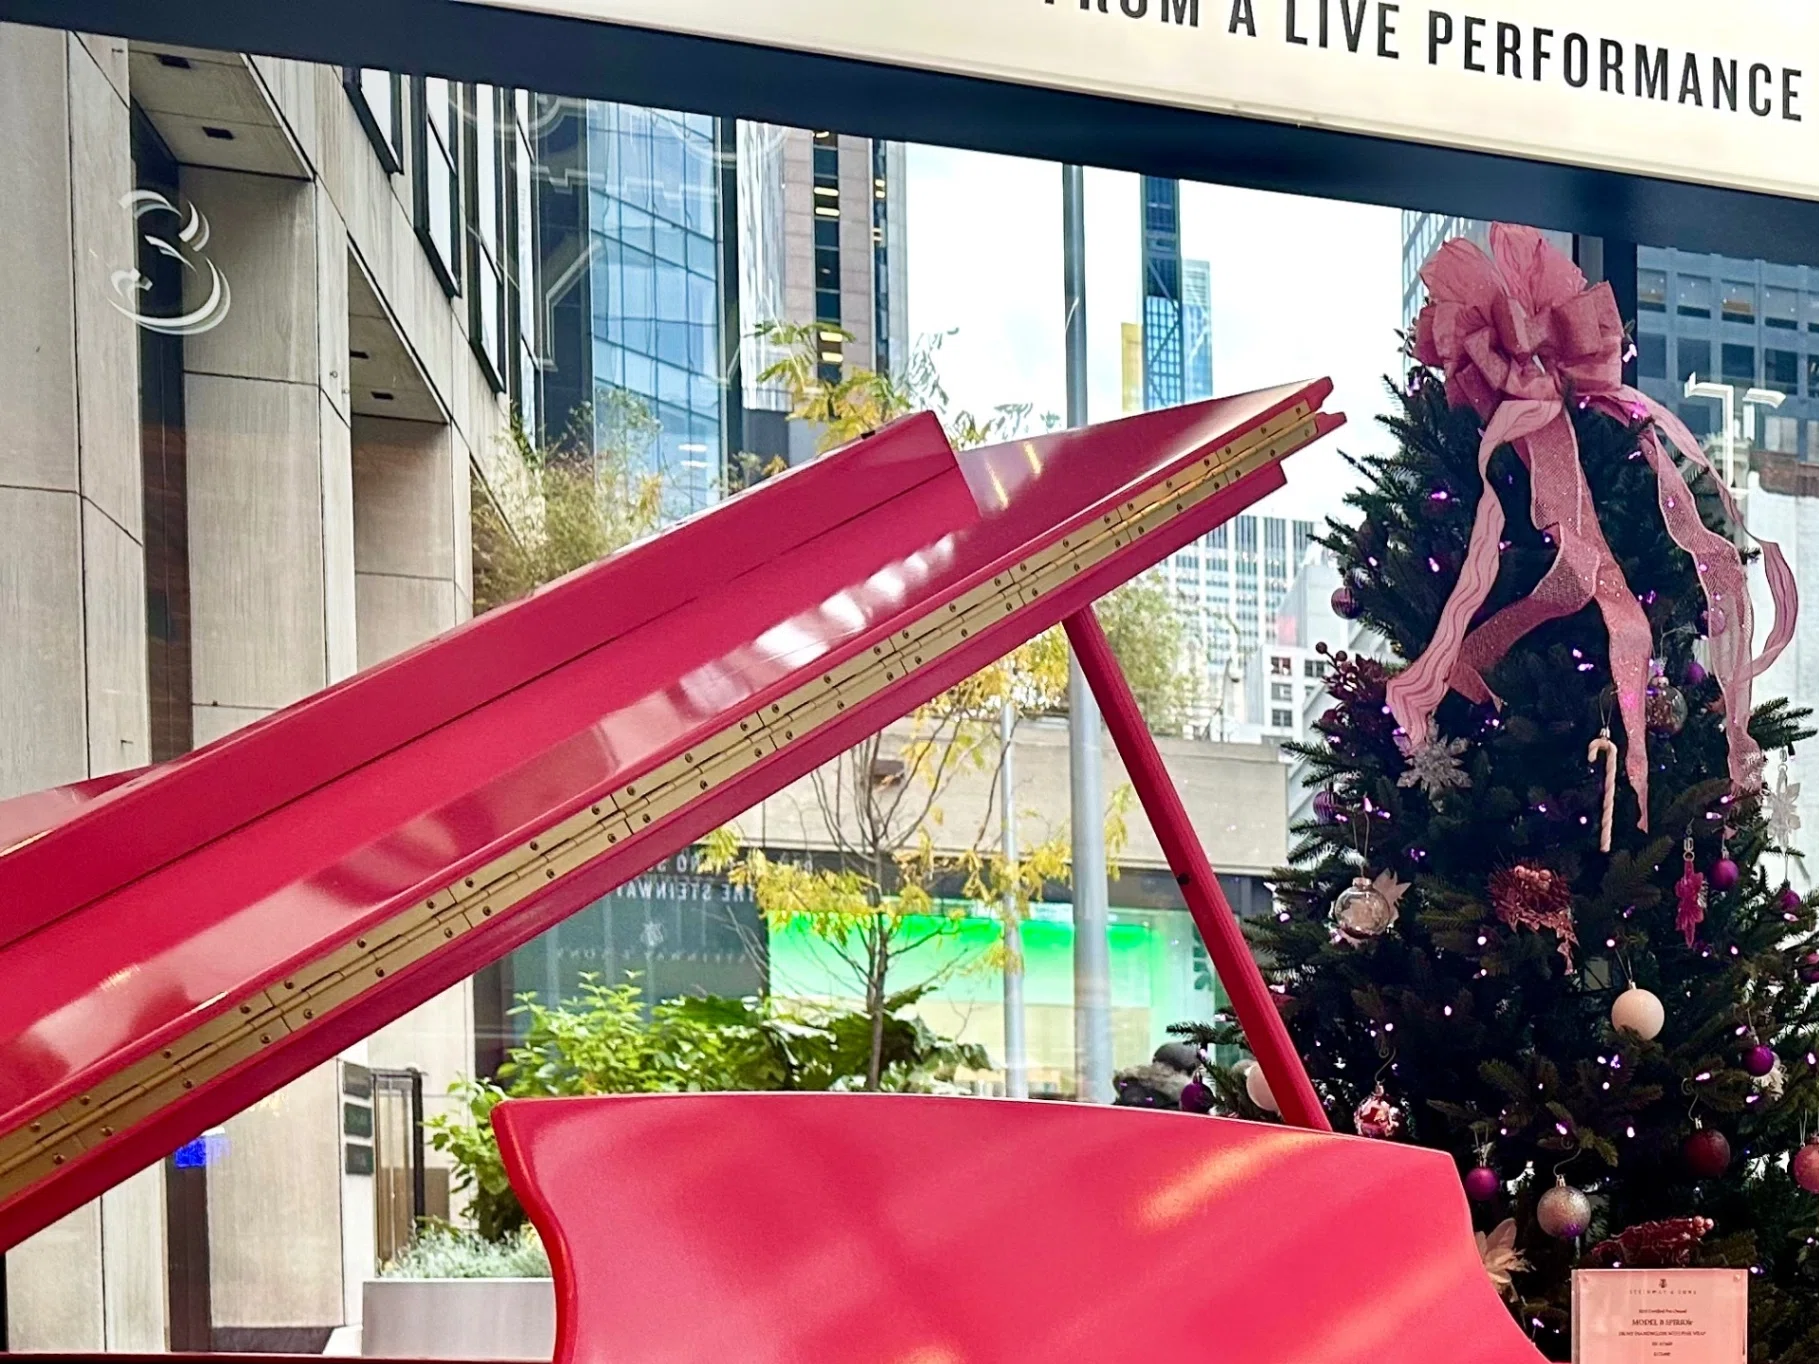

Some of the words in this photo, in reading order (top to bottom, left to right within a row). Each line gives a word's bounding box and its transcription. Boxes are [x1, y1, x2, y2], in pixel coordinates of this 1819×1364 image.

[1228, 0, 1257, 37] A
[1286, 0, 1399, 60] LIVE
[1428, 9, 1803, 122] PERFORMANCE
